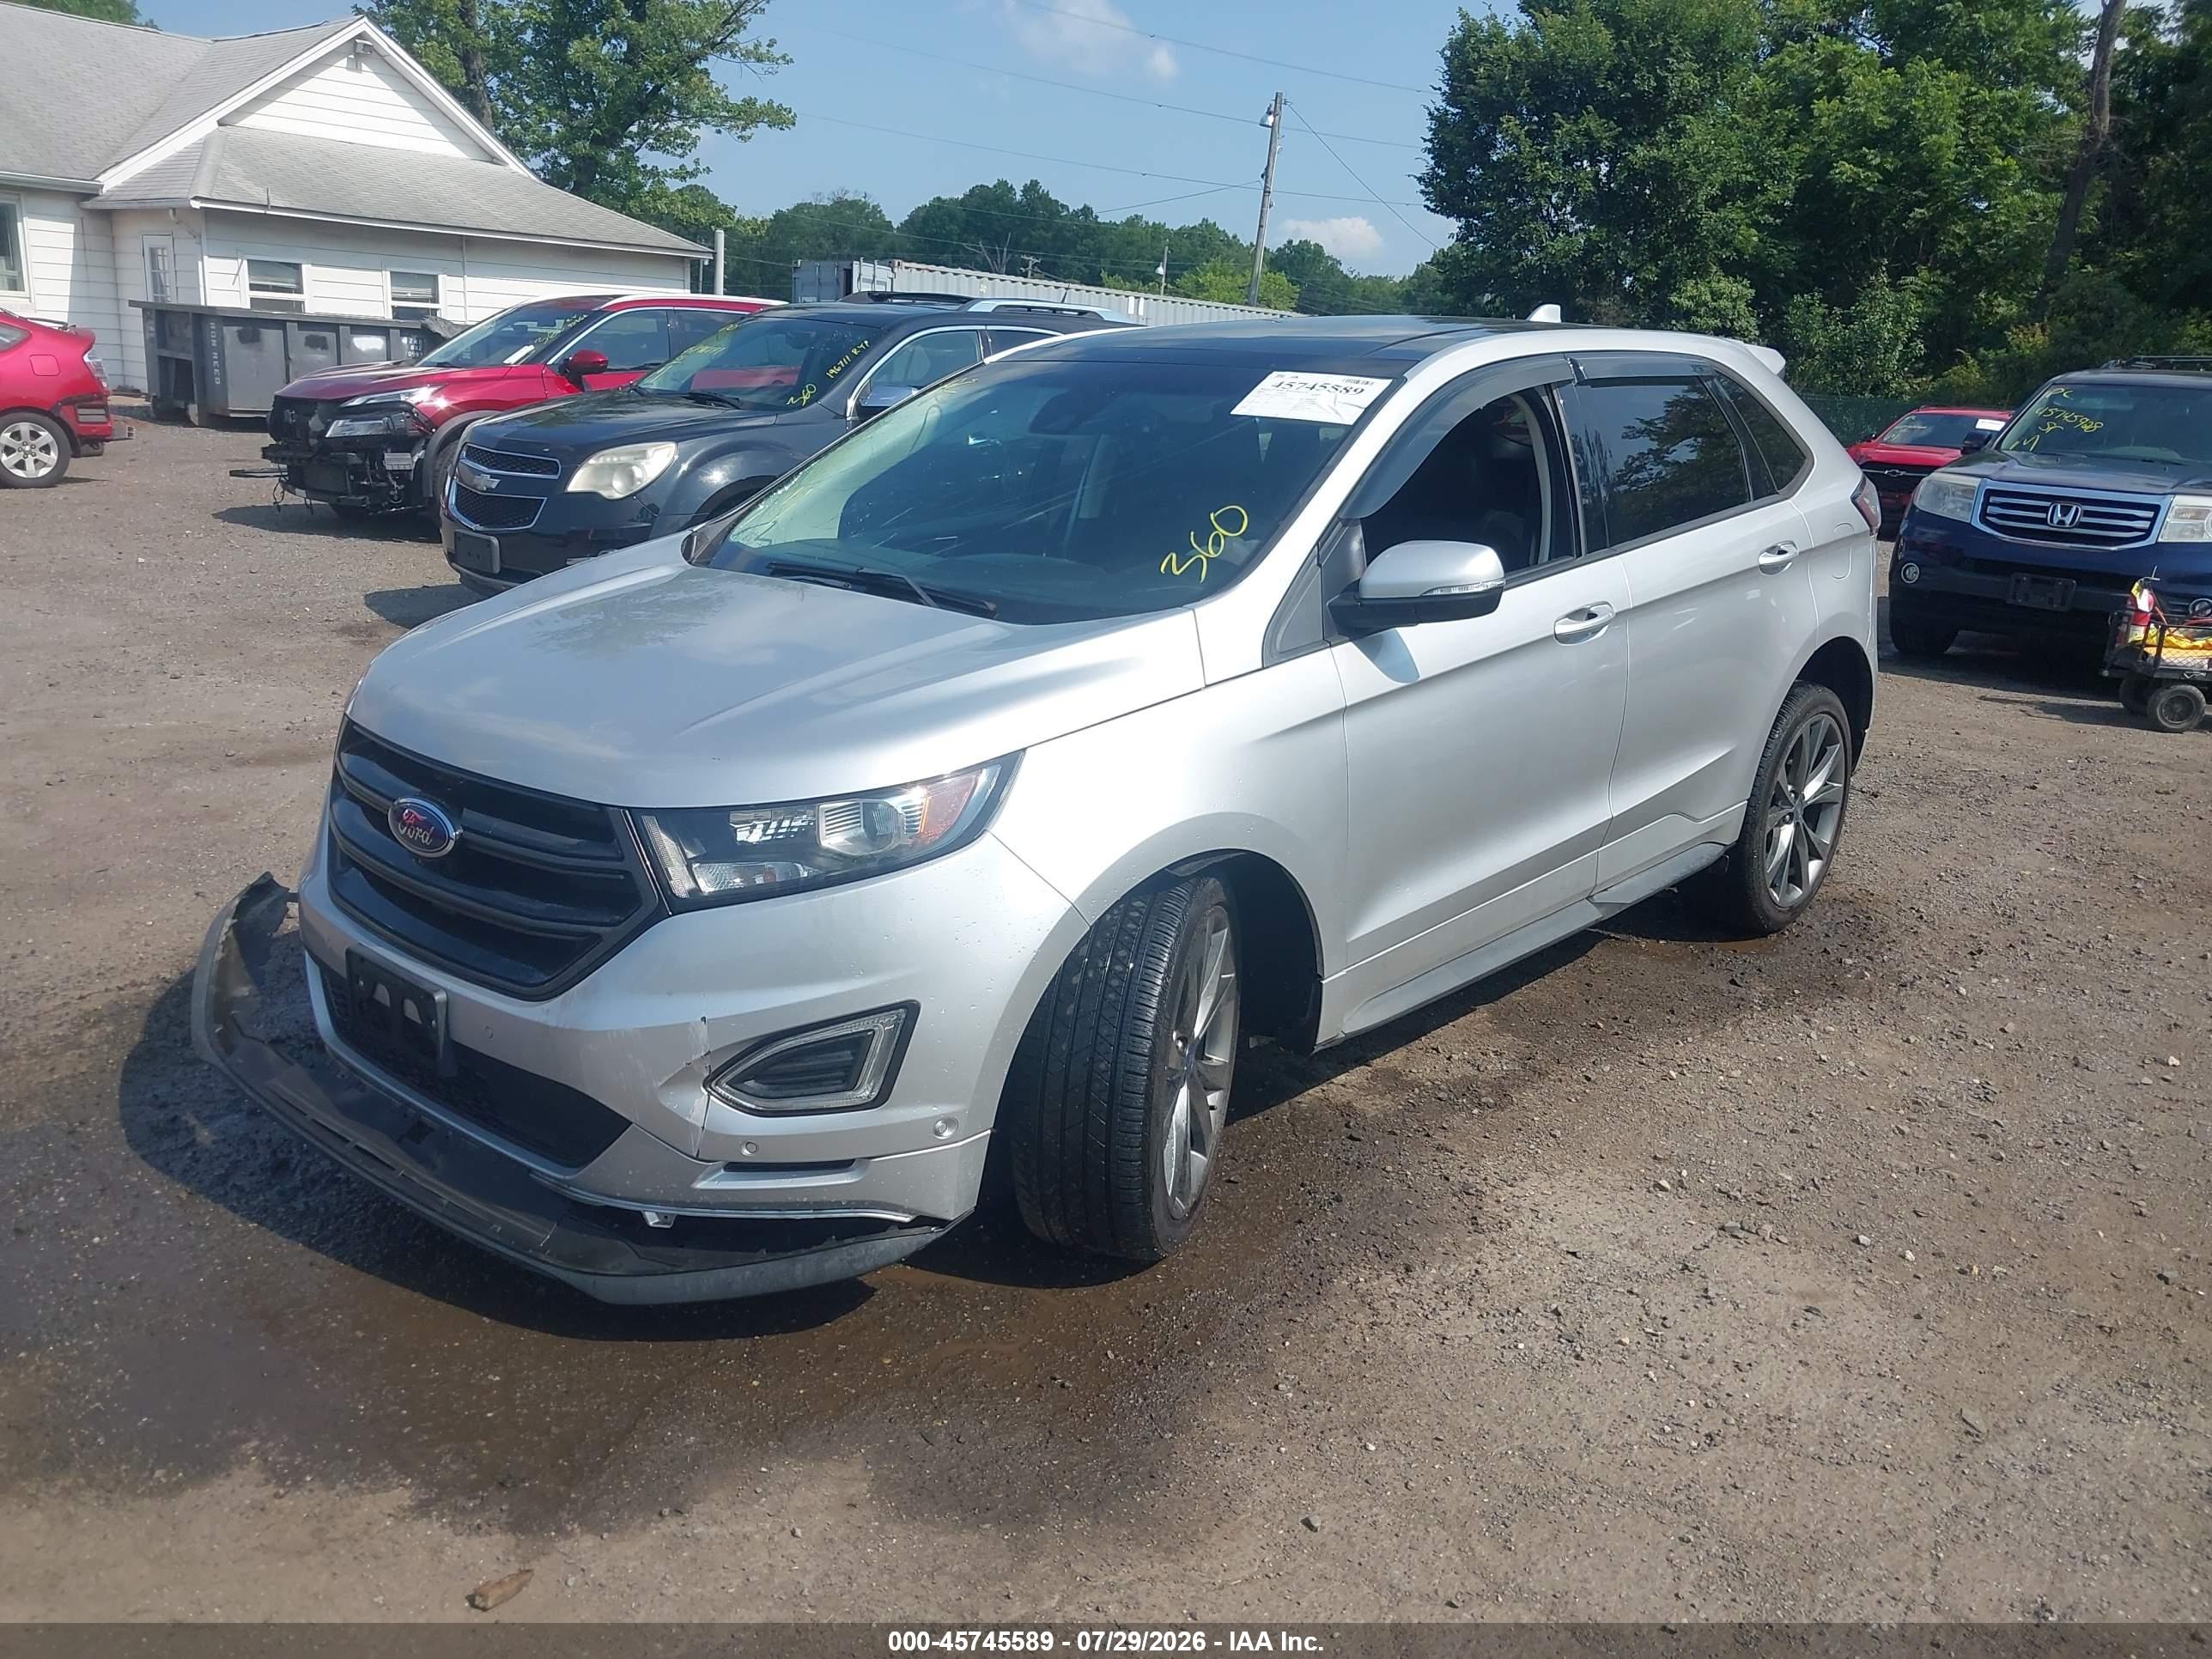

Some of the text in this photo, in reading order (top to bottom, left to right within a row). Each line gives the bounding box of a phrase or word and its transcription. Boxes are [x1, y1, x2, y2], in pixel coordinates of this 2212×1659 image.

[825, 355, 851, 379] 196711
[786, 383, 817, 407] 360
[1271, 380, 1364, 396] 45745589
[1160, 505, 1249, 584] 360
[398, 808, 434, 846] Ford
